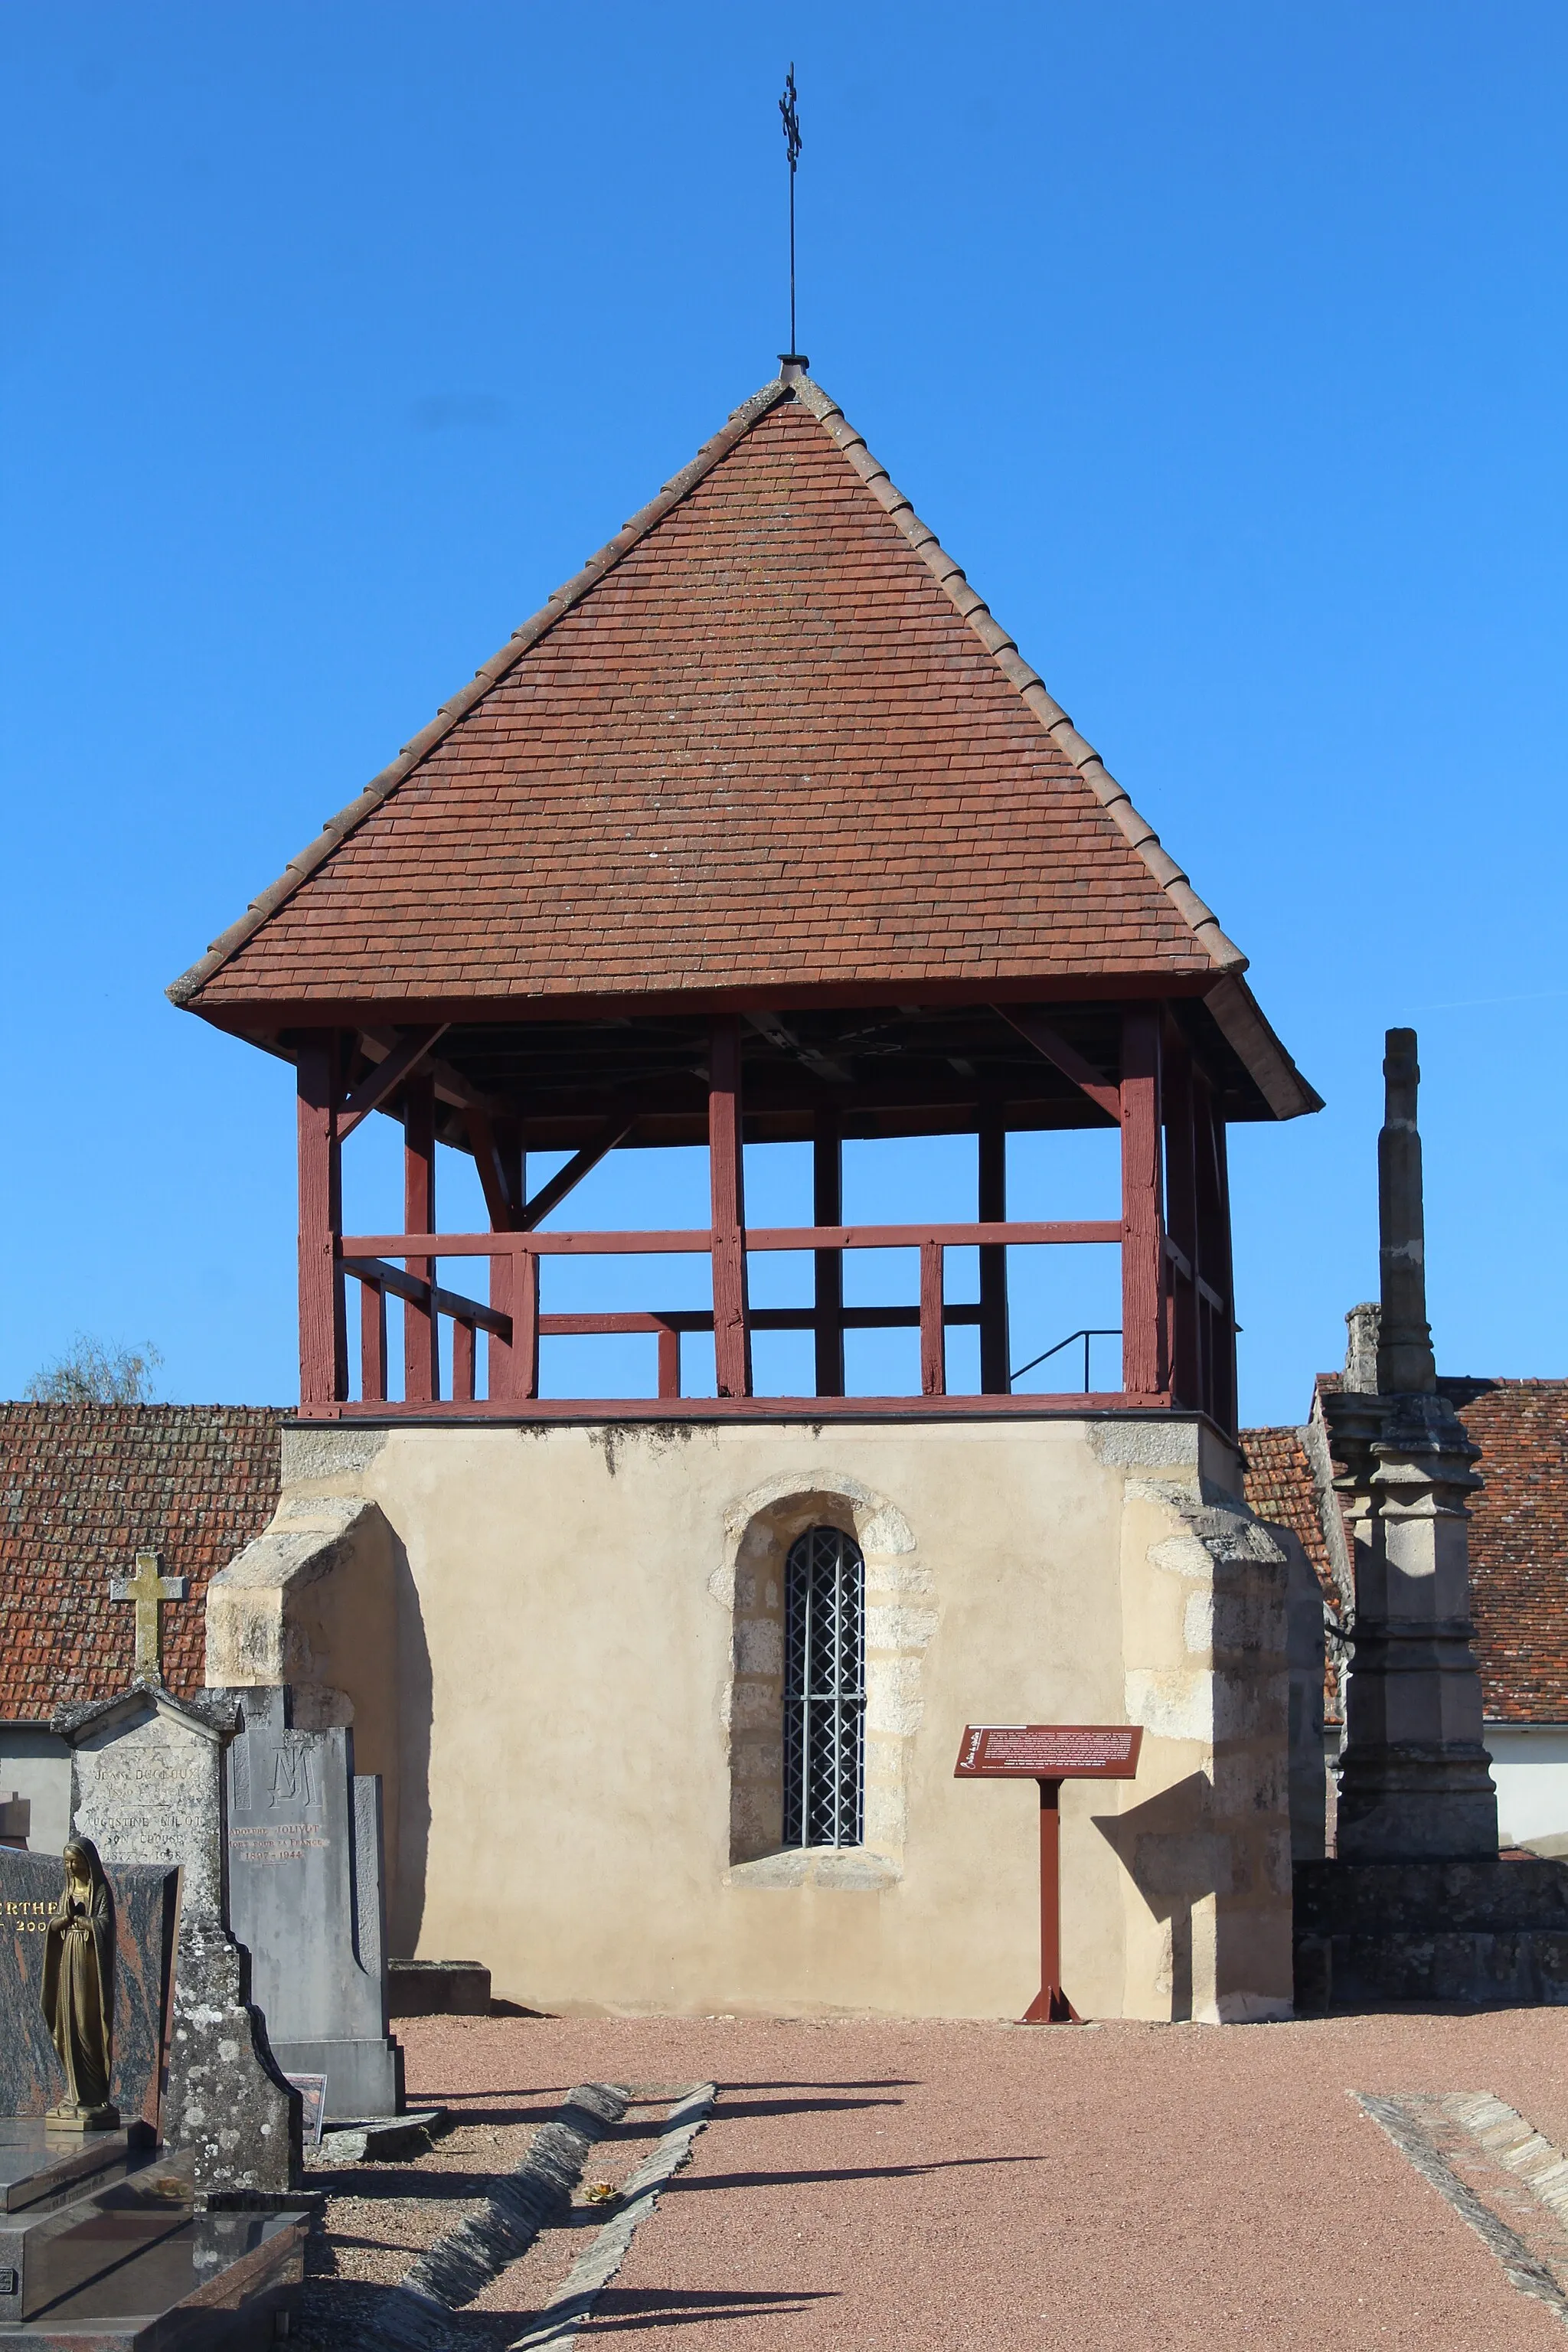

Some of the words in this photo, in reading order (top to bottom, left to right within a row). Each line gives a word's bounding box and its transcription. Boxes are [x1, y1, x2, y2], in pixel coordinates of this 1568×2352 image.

[94, 1770, 128, 1781] JEAN
[136, 1769, 198, 1780] DUCLOUX
[84, 1817, 149, 1828] AUGUSTINE
[229, 1827, 269, 1837] ADOLPHE
[276, 1824, 319, 1834] JOLIVOT
[106, 1834, 129, 1845] SON
[0, 1902, 60, 1915] RTHE
